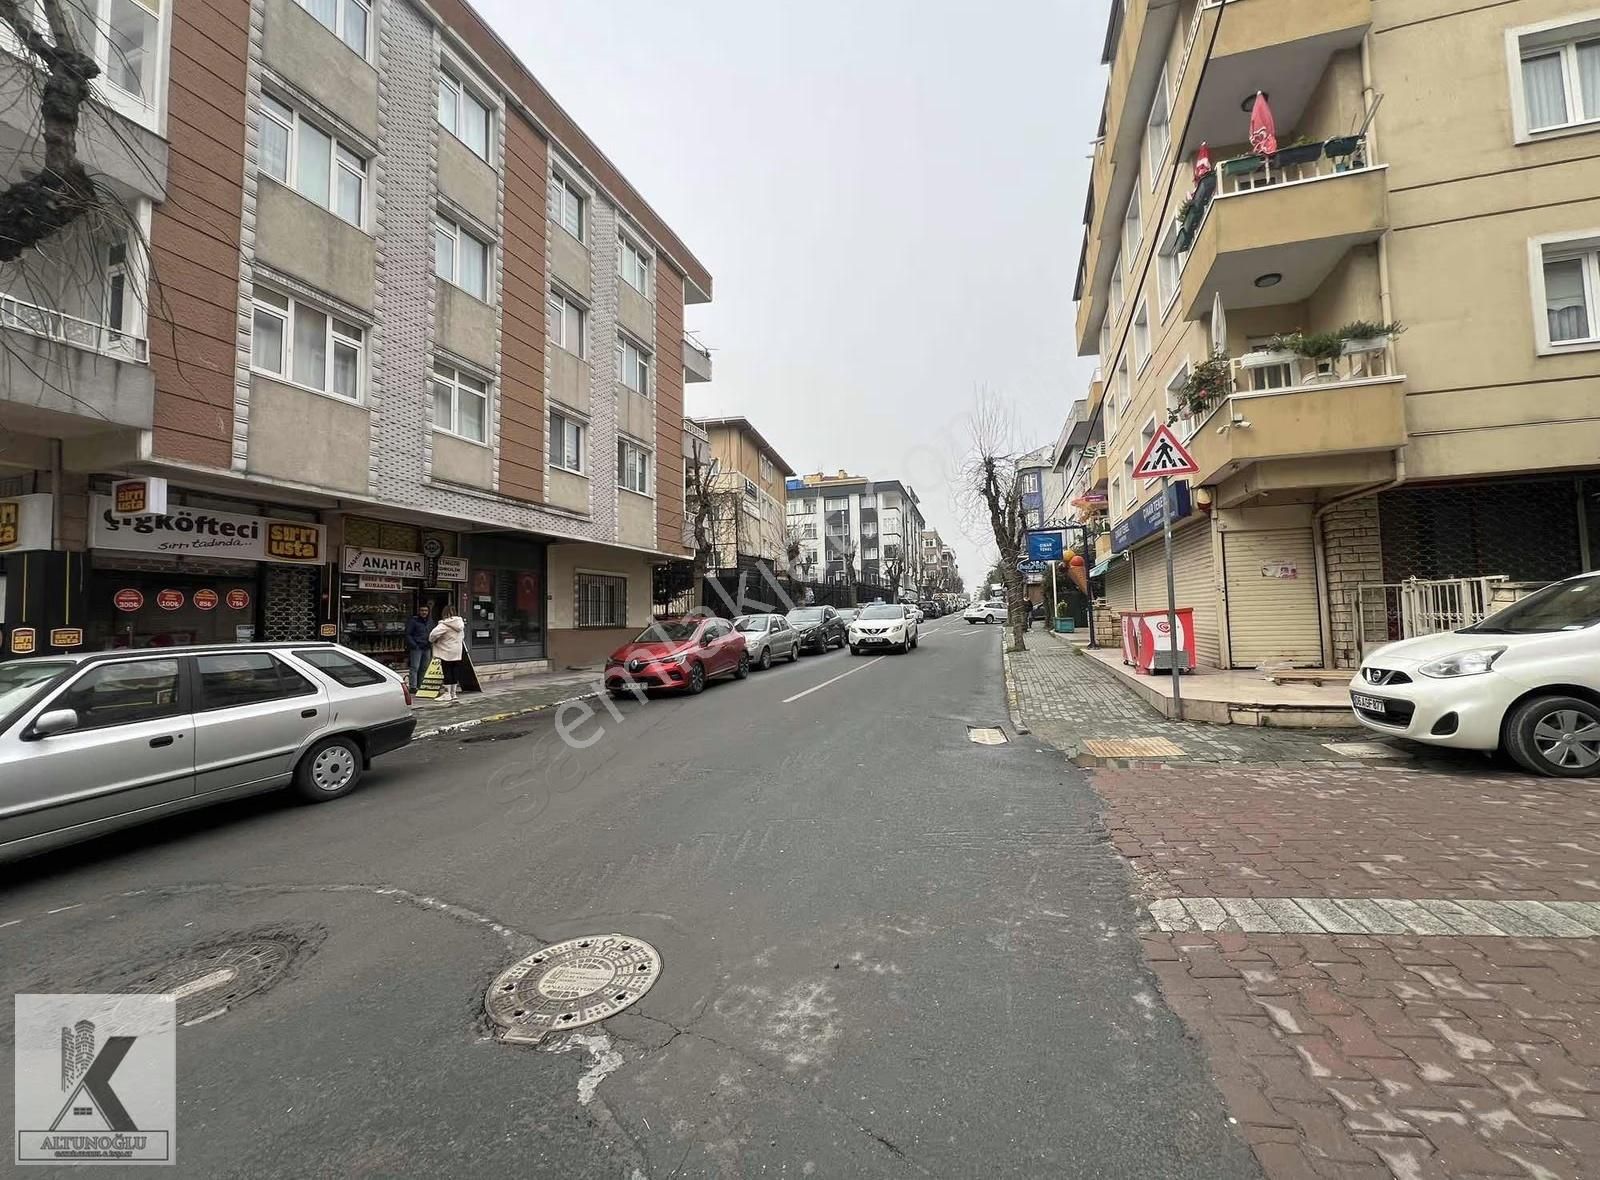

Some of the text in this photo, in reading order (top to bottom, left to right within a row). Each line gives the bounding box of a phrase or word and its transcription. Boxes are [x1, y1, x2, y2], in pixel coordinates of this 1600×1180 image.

[118, 500, 143, 510] usta
[271, 539, 315, 557] usta
[362, 556, 422, 572] ANAHTAR
